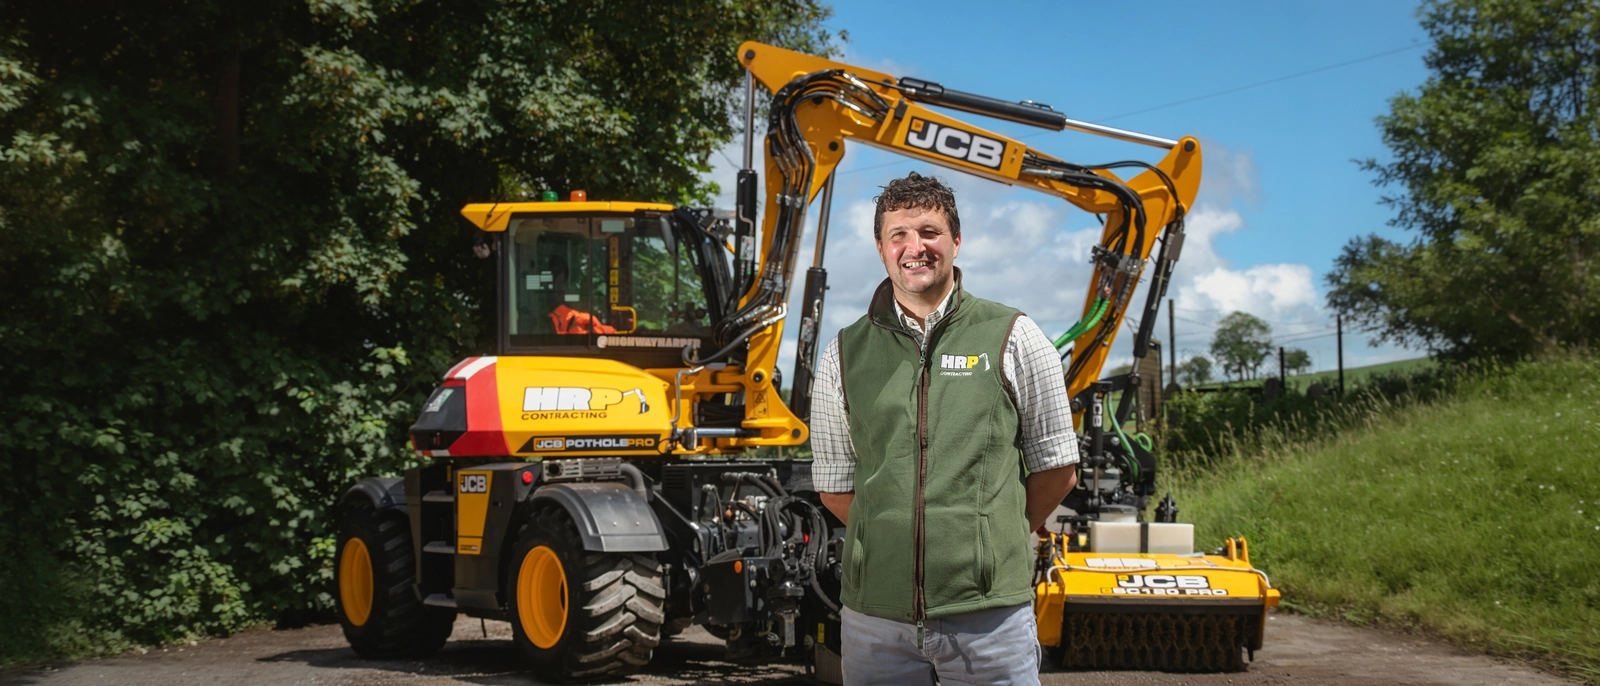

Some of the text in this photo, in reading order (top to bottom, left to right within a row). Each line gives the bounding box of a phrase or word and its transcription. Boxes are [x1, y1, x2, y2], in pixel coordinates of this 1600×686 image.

[907, 122, 1004, 168] JCB
[940, 354, 979, 369] HRP
[522, 387, 623, 411] HRP
[521, 411, 607, 421] CONTRACTING
[1093, 392, 1103, 427] JCB
[536, 439, 563, 449] JCB
[460, 475, 487, 493] JCB
[1117, 574, 1209, 588] JCB
[1184, 588, 1227, 596] PRO
